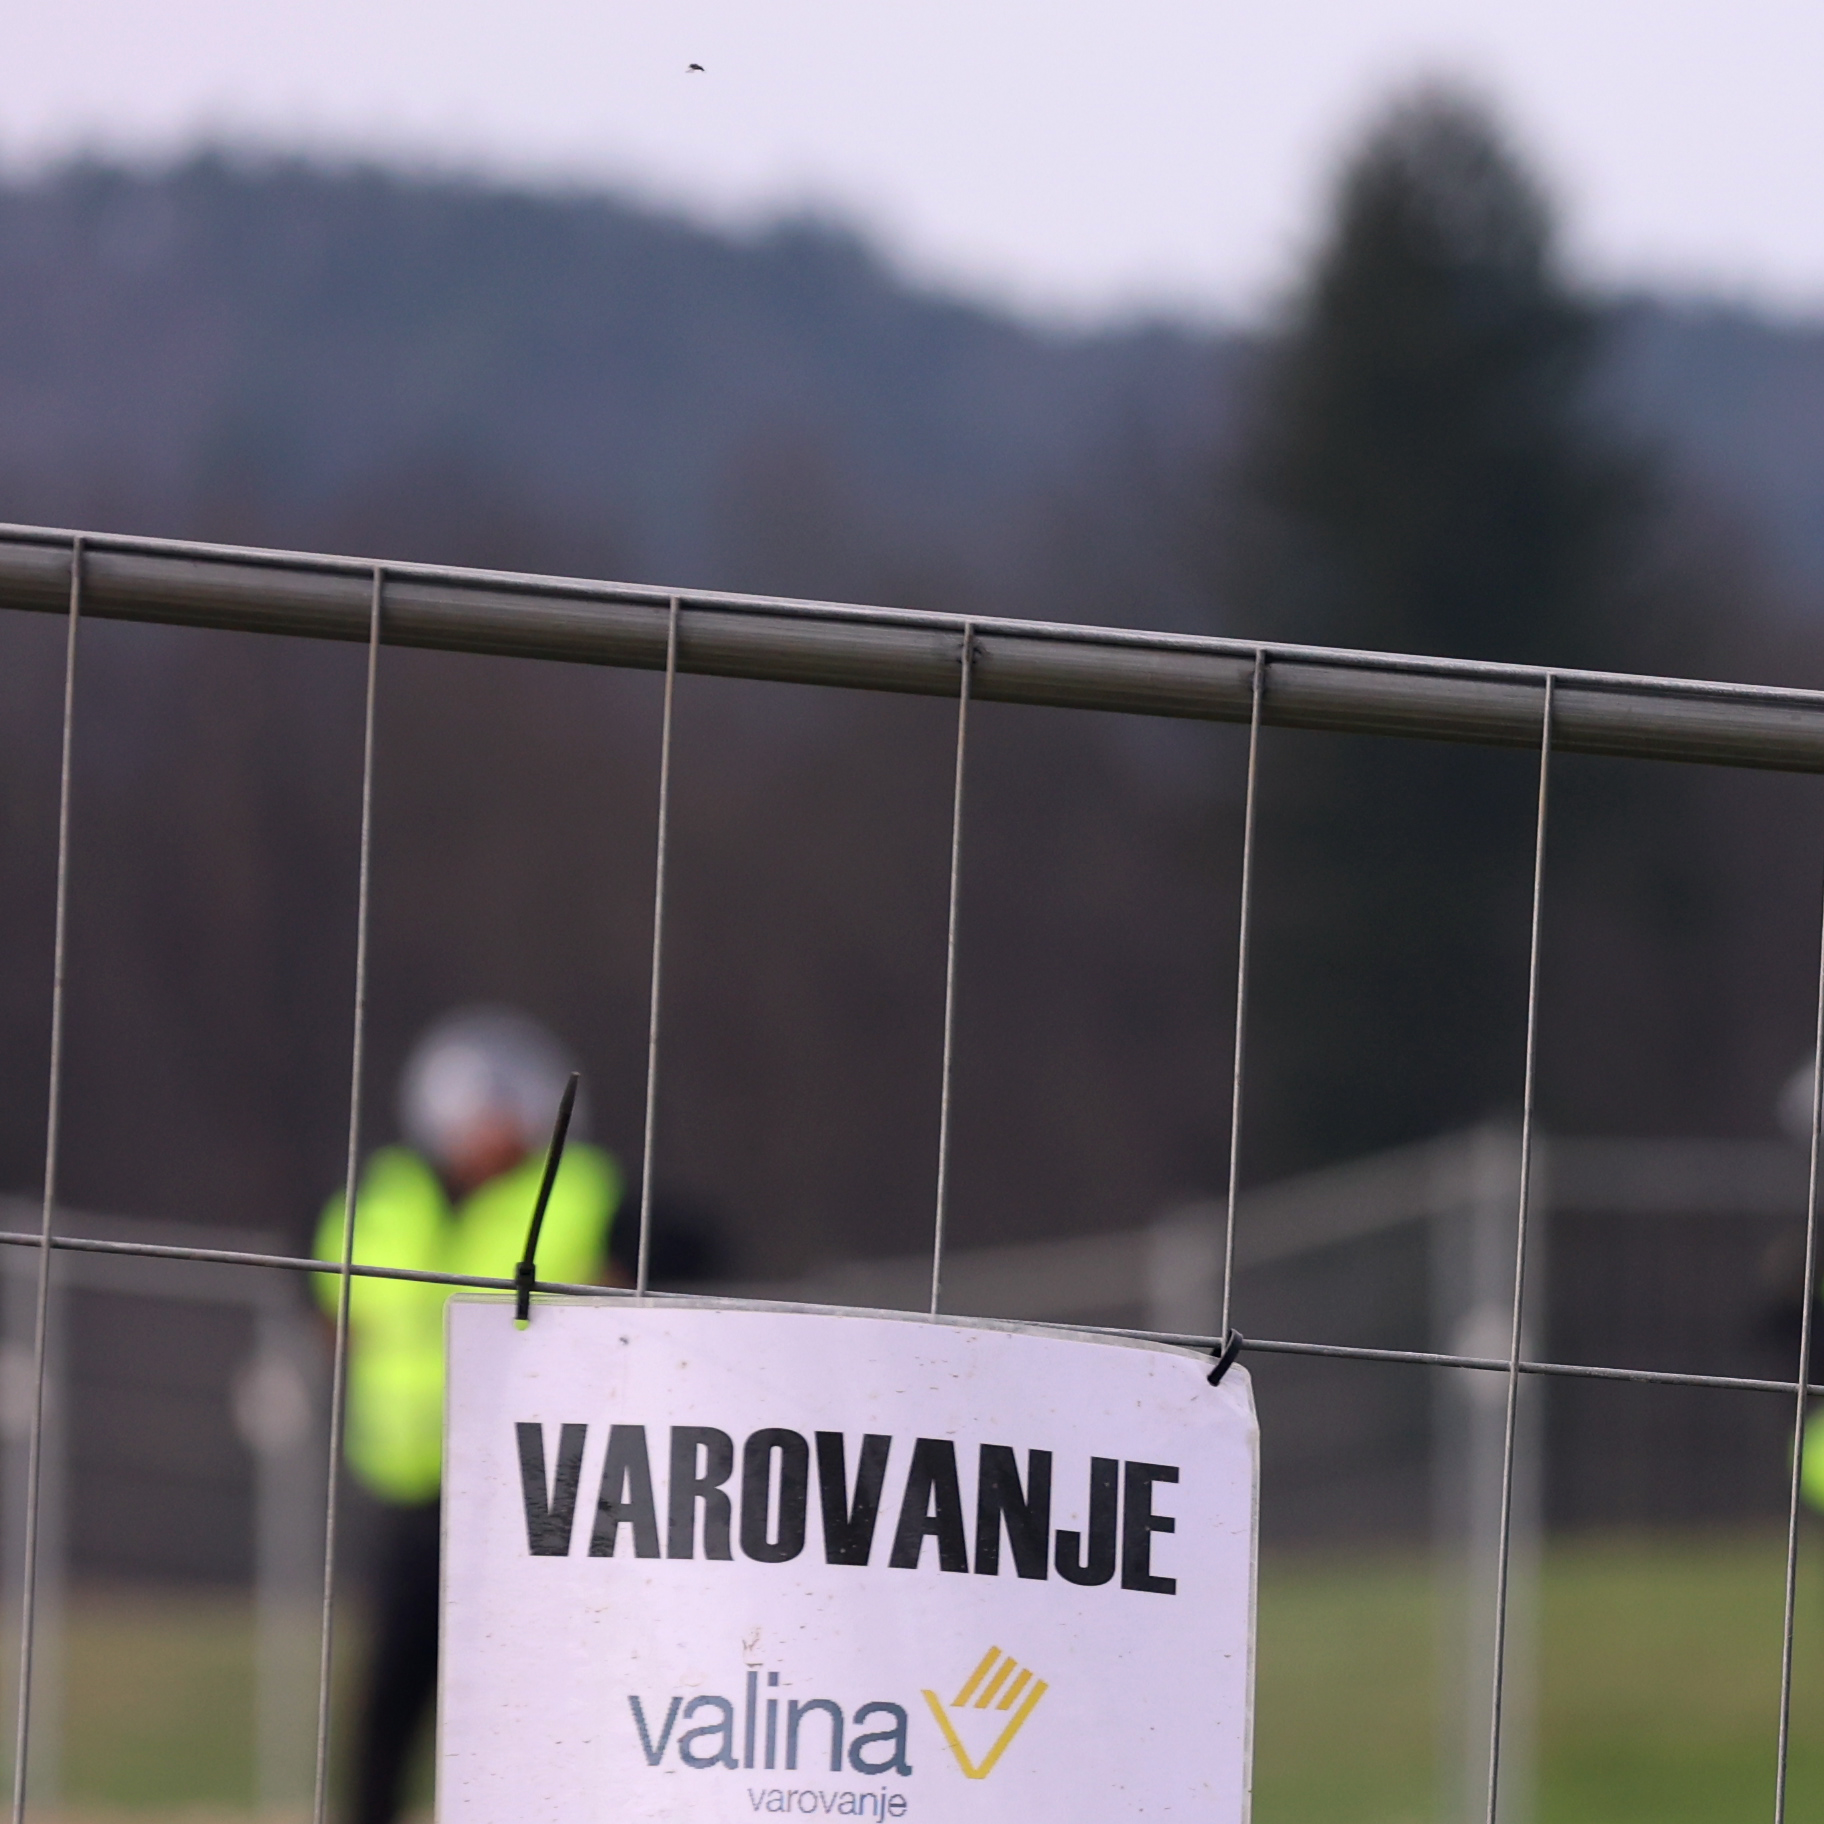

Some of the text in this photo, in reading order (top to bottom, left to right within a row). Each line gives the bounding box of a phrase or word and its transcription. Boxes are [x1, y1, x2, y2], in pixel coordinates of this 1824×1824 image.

[514, 1421, 1180, 1595] VAROVANJE
[628, 1670, 913, 1777] valina
[747, 1786, 908, 1824] varovanje
